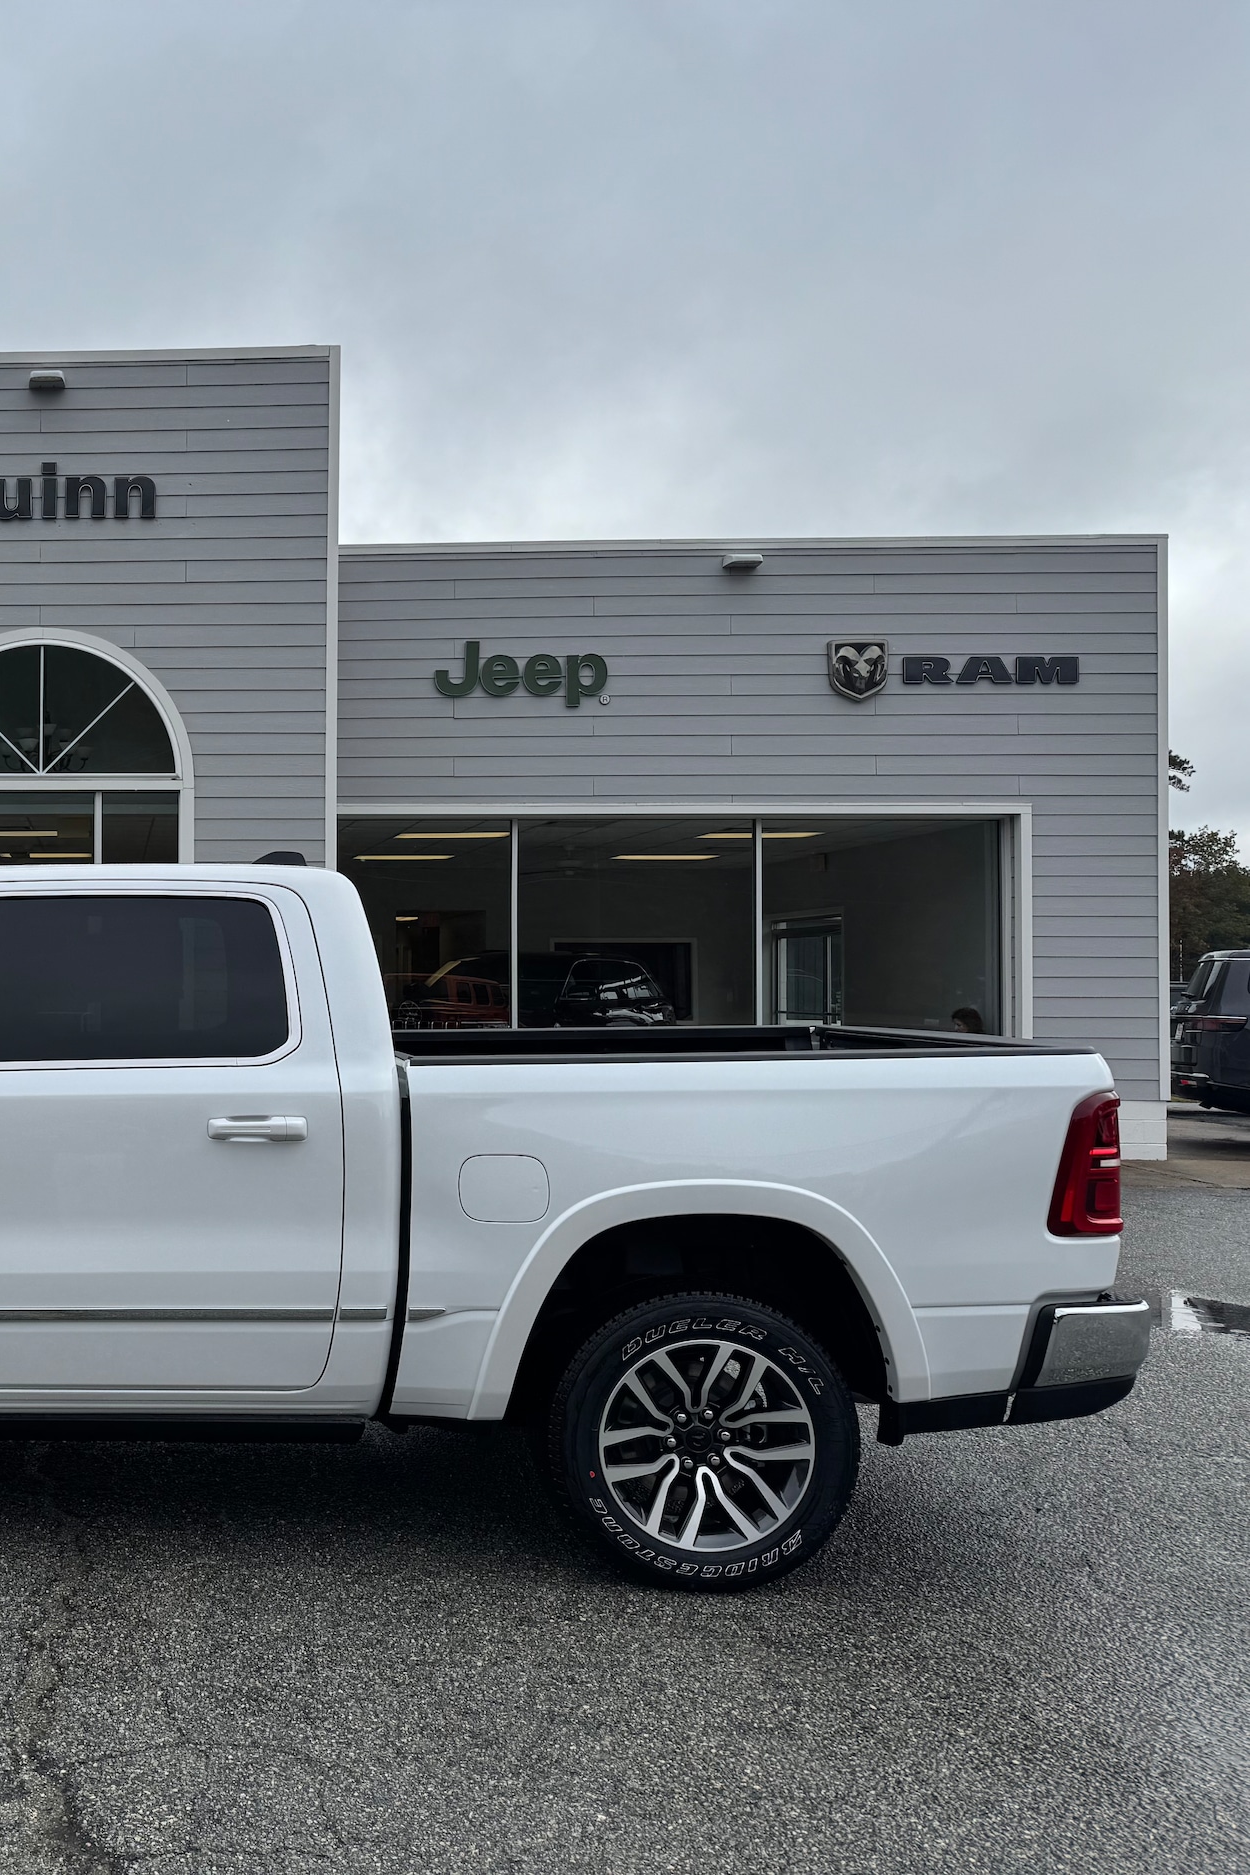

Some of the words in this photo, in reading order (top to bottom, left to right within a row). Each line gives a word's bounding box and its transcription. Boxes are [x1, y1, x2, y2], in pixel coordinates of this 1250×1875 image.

[435, 641, 608, 707] Jeep
[903, 656, 1080, 684] RAM
[621, 1317, 768, 1361] DUELER
[778, 1346, 825, 1396] H/L
[588, 1497, 803, 1578] BRIDGESTONE
